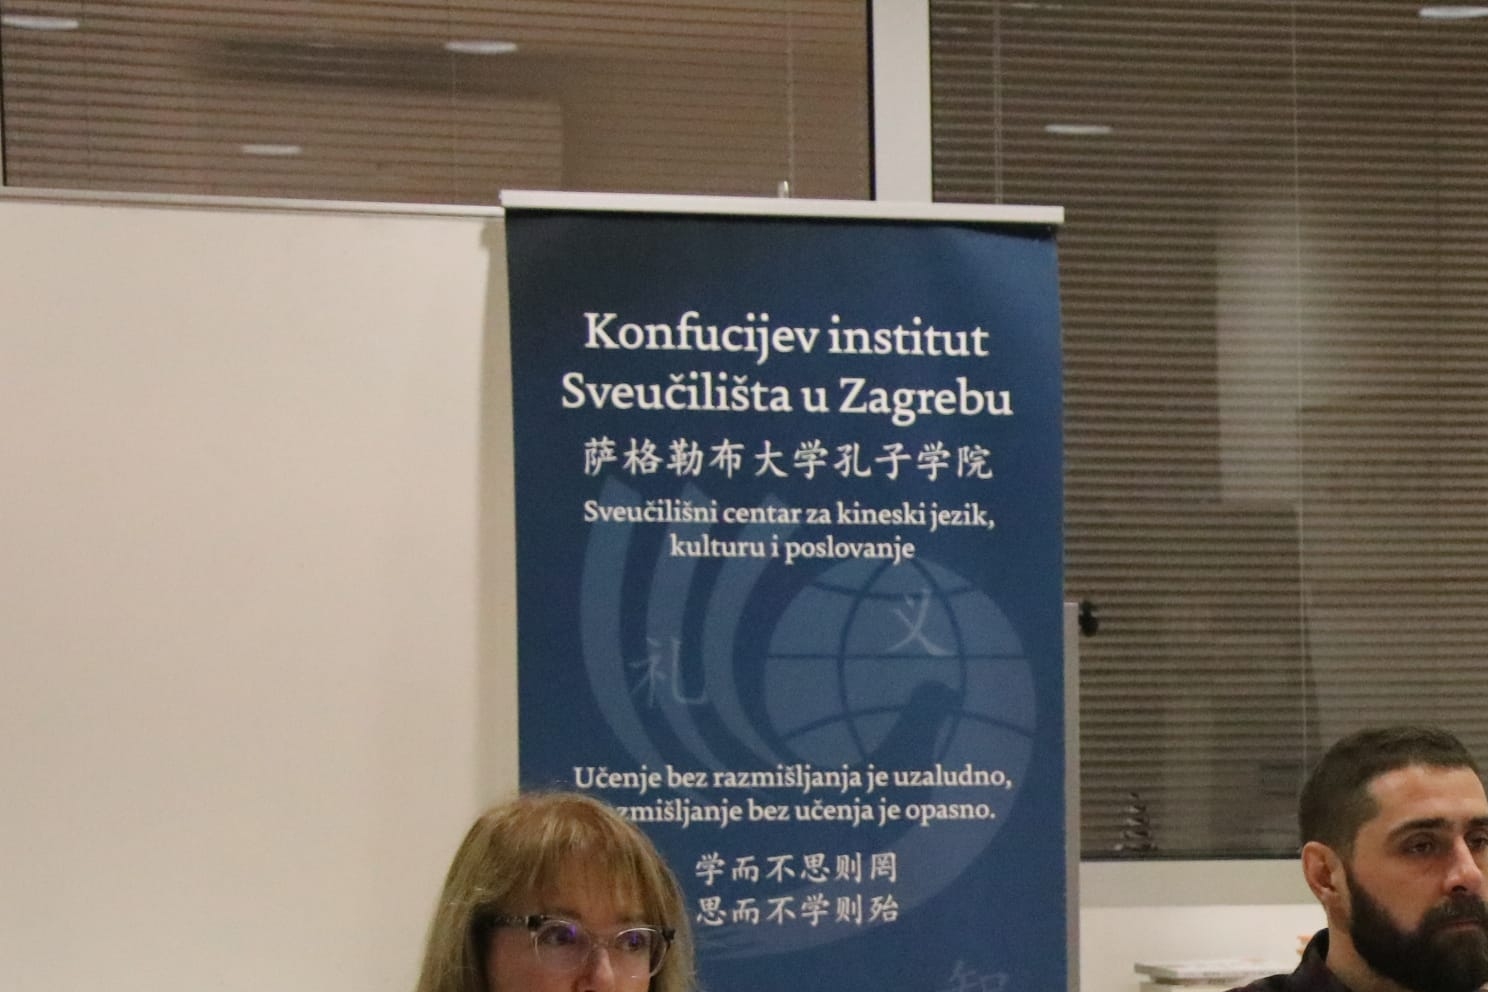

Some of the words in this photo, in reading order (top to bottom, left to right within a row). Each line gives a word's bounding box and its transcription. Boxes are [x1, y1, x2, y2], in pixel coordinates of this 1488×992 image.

[583, 311, 819, 364] Konfucijev
[828, 314, 989, 357] institut
[562, 371, 792, 412] Sveučilišta
[801, 388, 830, 413] u
[839, 376, 1014, 426] Zagrebu
[583, 435, 993, 482] 萨格勒布大学孔子学院
[583, 499, 718, 524] Sveučilišni
[722, 505, 802, 524] centar
[806, 508, 832, 525] za
[837, 502, 926, 526] kineski
[929, 503, 996, 532] jezik,
[669, 532, 766, 559] kulturu
[770, 534, 779, 558] i
[784, 534, 915, 566] poslovanje
[574, 764, 662, 794] Učenje
[665, 764, 708, 788] bez
[713, 764, 863, 794] razmišljanja
[867, 764, 889, 793] je
[893, 764, 1012, 791] uzaludno,
[616, 799, 743, 828] zmišljanje
[748, 798, 790, 821] bez
[795, 798, 874, 827] učenja
[878, 797, 901, 827] je
[905, 803, 996, 828] opasno.
[696, 892, 900, 927] 思而不学则殆
